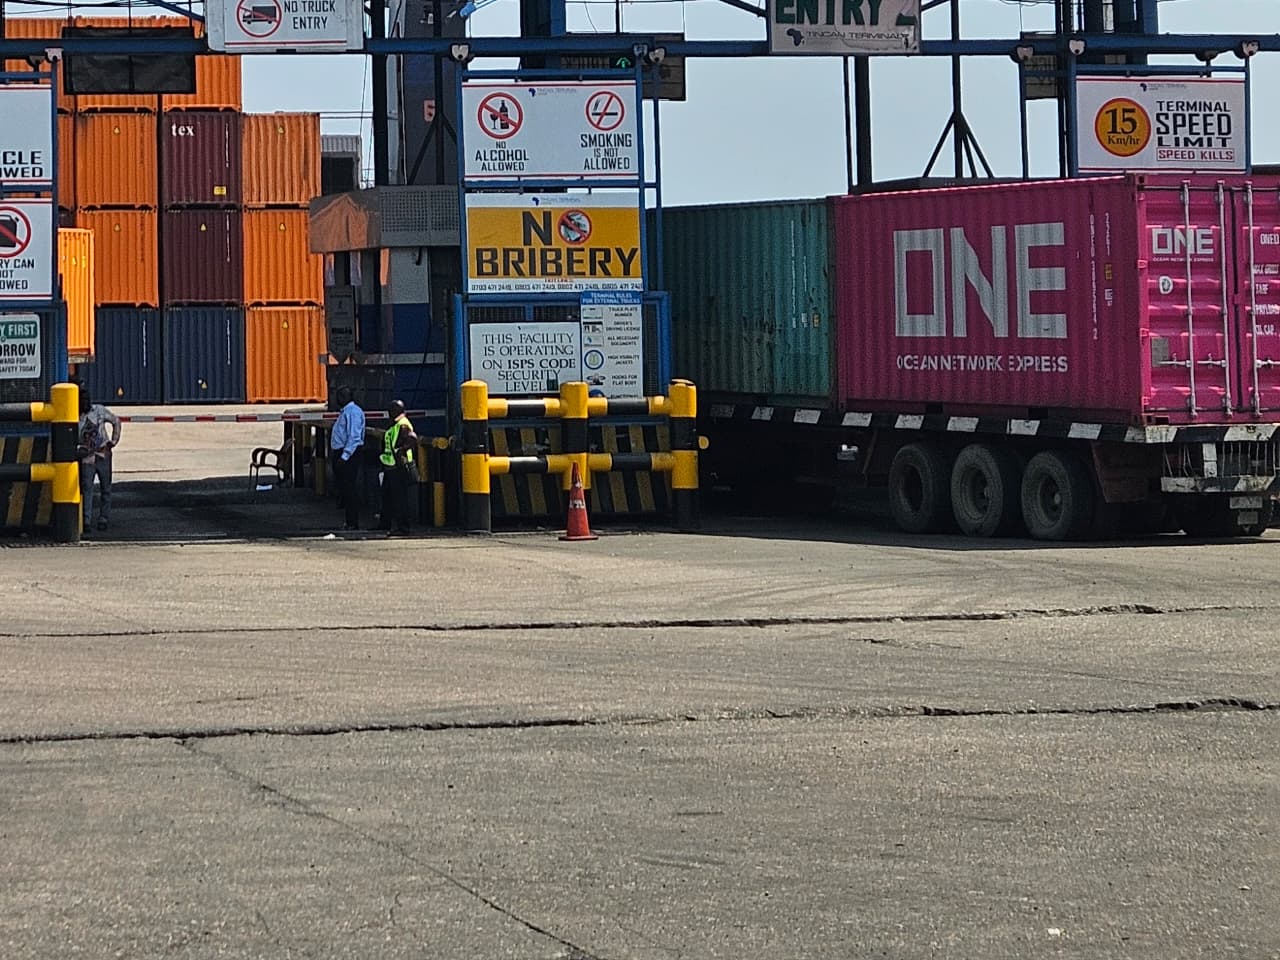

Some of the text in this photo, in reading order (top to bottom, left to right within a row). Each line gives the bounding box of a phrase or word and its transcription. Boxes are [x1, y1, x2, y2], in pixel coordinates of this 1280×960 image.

[284, 0, 336, 12] NO TRUCK
[292, 16, 328, 29] ENTRY
[848, 31, 905, 39] TERMINAL
[1156, 101, 1232, 112] TERMINAL
[1105, 108, 1137, 135] 15
[1156, 113, 1232, 136] SPEED
[171, 123, 195, 137] tex
[496, 141, 506, 149] NO
[580, 133, 632, 148] SMOKING
[1107, 135, 1140, 146] Km/hr
[1157, 136, 1232, 147] LIMIT
[475, 149, 529, 161] ALCOHOL
[593, 148, 619, 157] IS NOT
[1158, 150, 1234, 160] SPEED KILLS
[481, 161, 525, 171] ALLOWED
[583, 157, 630, 170] ALLOWED
[1152, 228, 1214, 254] ONE
[13, 259, 34, 269] CAN
[476, 247, 639, 276] BRIBERY
[893, 222, 1068, 339] ONE
[8, 324, 35, 336] FIRST
[482, 333, 574, 344] THIS FACILITY
[484, 345, 574, 356] IS OPERATING
[482, 358, 576, 370] ON ISPS CODE
[897, 355, 1068, 372] OCEAN NETWORK EXPRESS
[498, 369, 560, 380] SECURITY
[505, 381, 546, 392] LEVEL
